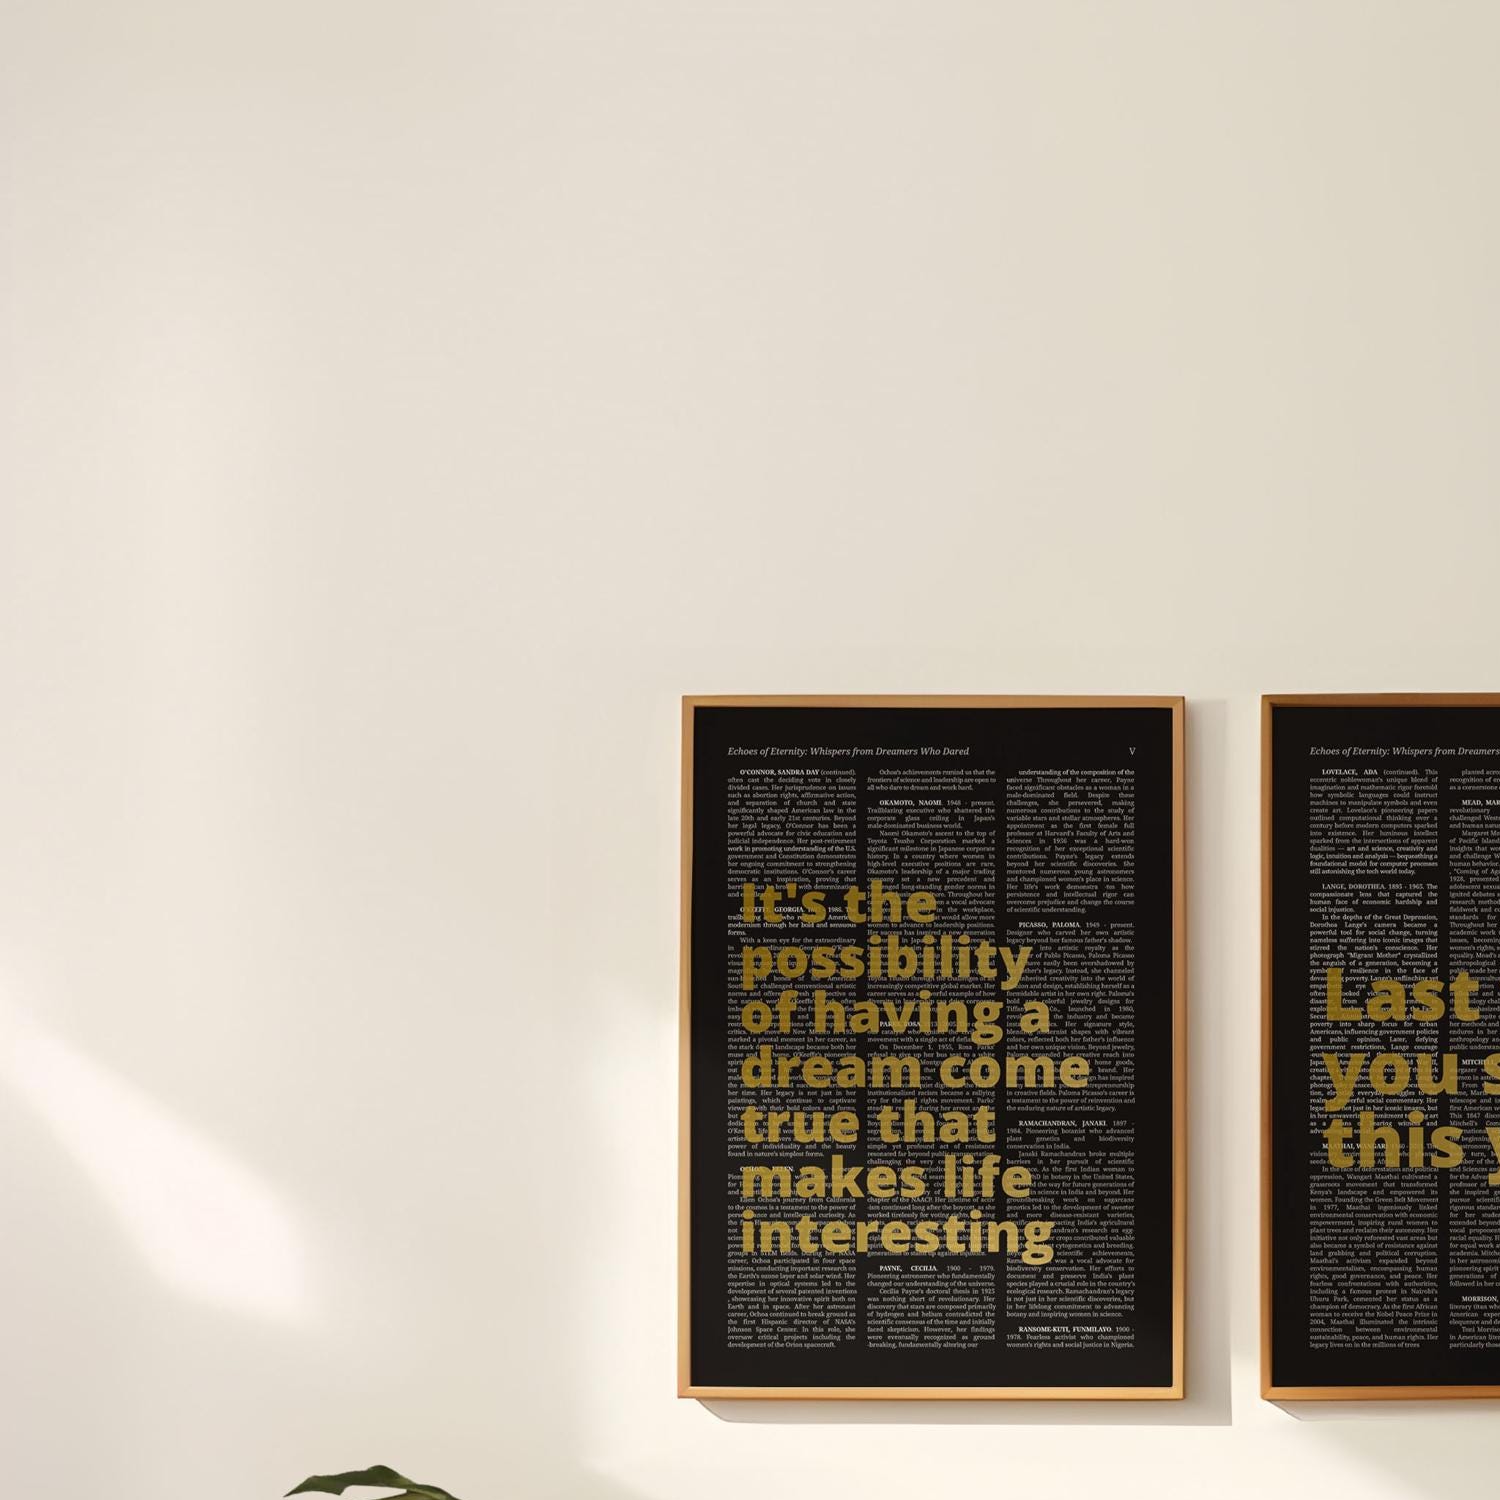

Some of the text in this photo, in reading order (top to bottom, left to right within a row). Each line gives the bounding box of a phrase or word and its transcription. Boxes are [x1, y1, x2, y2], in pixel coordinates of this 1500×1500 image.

[727, 746, 969, 757] Echoes of Eternity: Whispers from Dreamers Who Dared
[1129, 746, 1136, 755] V
[1309, 746, 1340, 755] Echoes
[1341, 746, 1353, 757] of
[1352, 746, 1390, 757] Eternity:
[1392, 746, 1432, 757] Whispers
[1433, 746, 1456, 757] from
[1457, 746, 1500, 755] Dreamers
[740, 768, 776, 776] O'CONNOR,
[1322, 768, 1358, 776] LOVELACE,
[880, 799, 914, 807] OKAMOTO,
[1462, 799, 1483, 807] MEAD,
[752, 844, 783, 852] promoting
[784, 844, 826, 852] understanding
[1322, 867, 1355, 875] astonishing
[1398, 867, 1415, 875] today.
[743, 880, 937, 923] It's the
[1019, 921, 1048, 929] PICASSO,
[742, 934, 1031, 991] possibility
[1327, 967, 1480, 1021] Last
[741, 990, 1049, 1045] of having a
[741, 1044, 1089, 1088] dream come
[1322, 1053, 1457, 1112] you
[740, 1099, 996, 1143] true that
[1019, 1119, 1077, 1127] RAMACHANDRAN,
[1322, 1110, 1463, 1168] this
[742, 1154, 1032, 1198] makes life
[742, 1209, 1055, 1265] interesting
[880, 1264, 902, 1272] PAYNE,
[1462, 1294, 1498, 1302] MORRISON,
[1019, 1325, 1070, 1333] RANSOME-KUTI,
